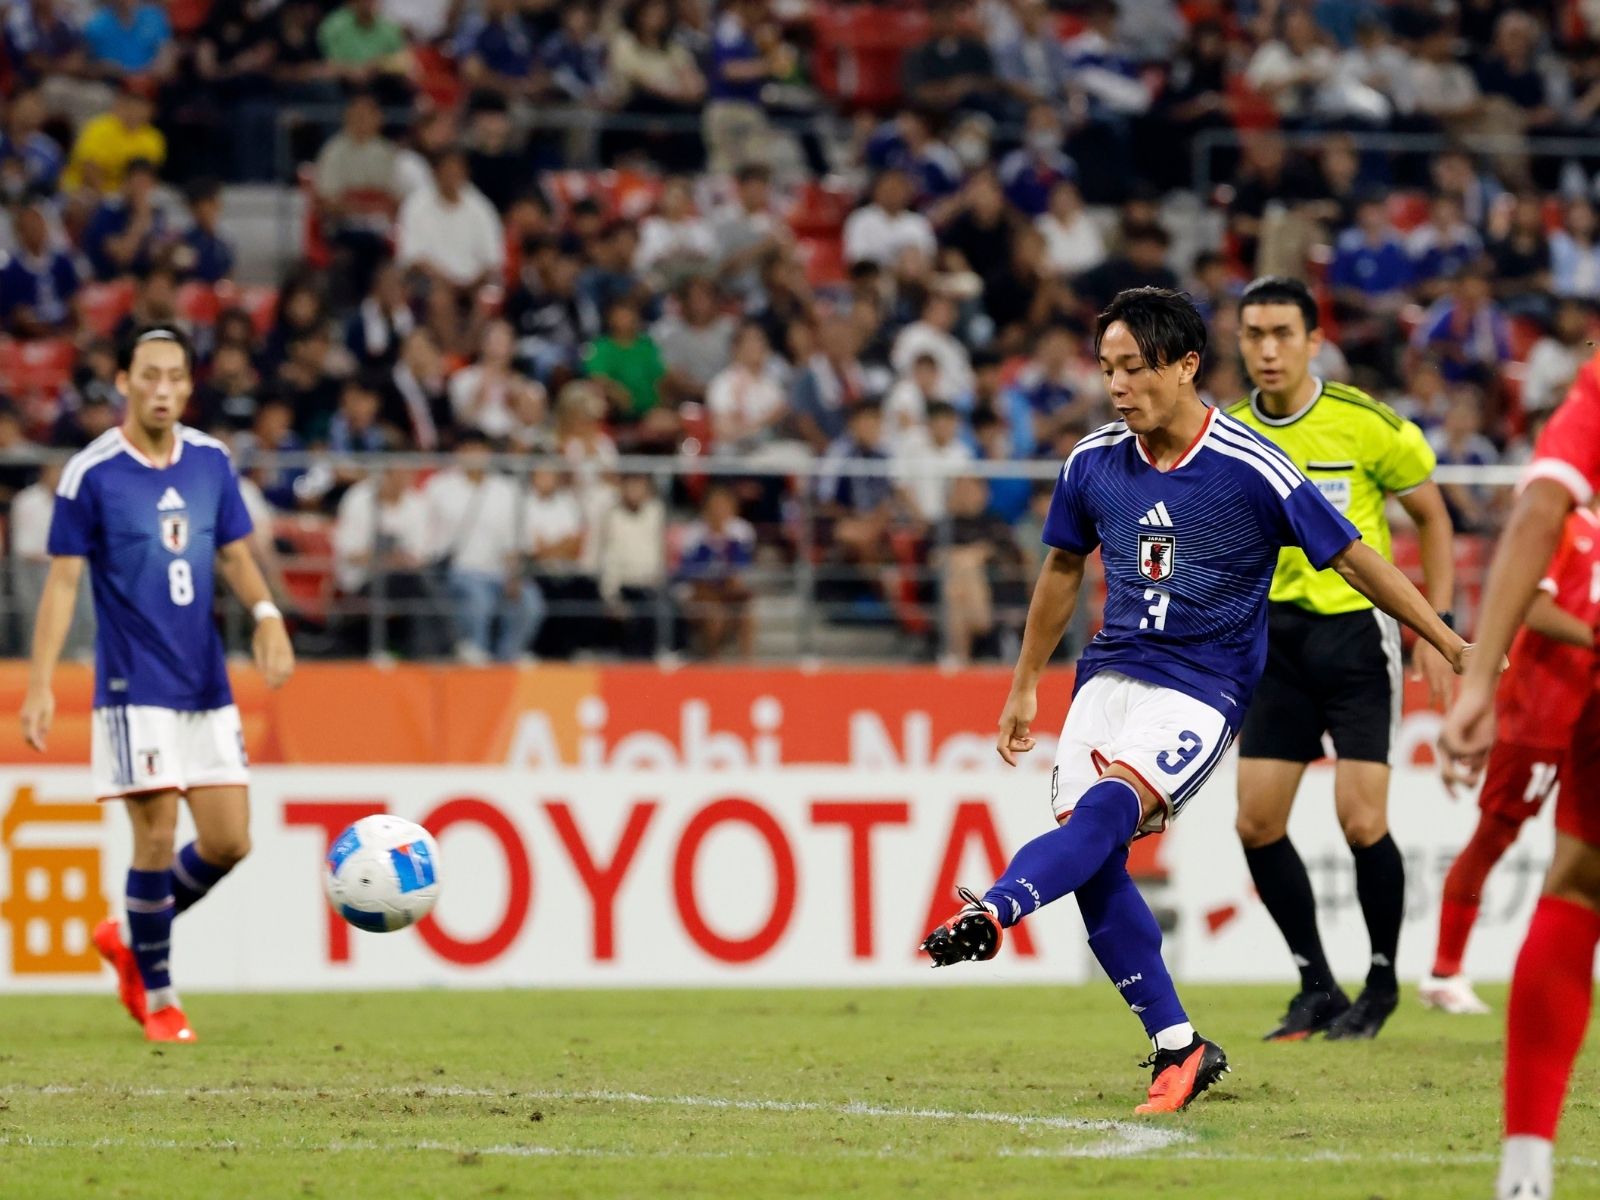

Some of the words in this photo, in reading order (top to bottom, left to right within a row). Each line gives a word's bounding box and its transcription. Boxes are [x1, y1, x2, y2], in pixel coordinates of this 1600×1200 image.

[168, 558, 195, 607] 8
[1139, 587, 1171, 631] 3
[1156, 729, 1203, 775] 3
[284, 797, 1037, 967] TOYOTA
